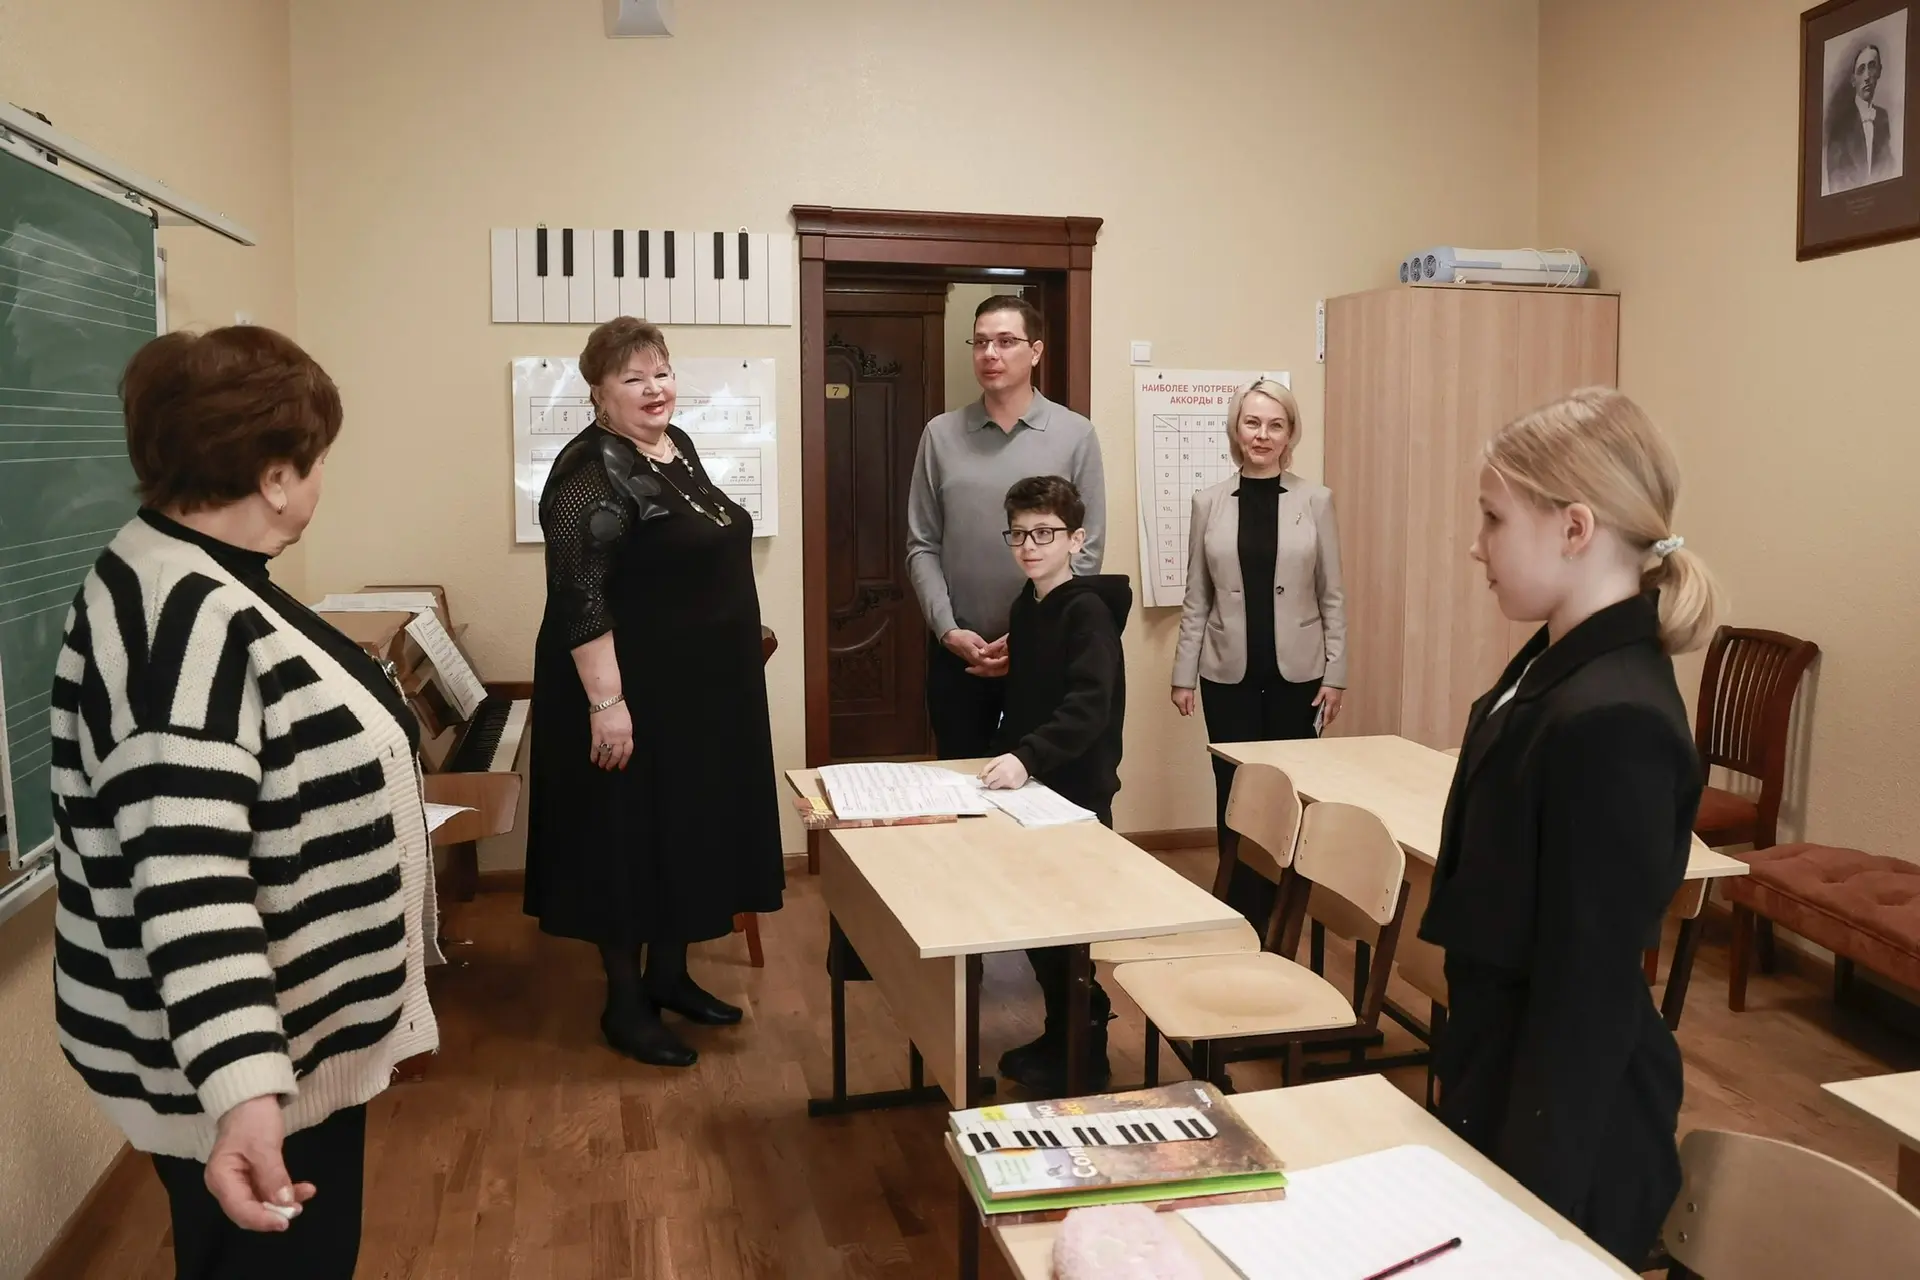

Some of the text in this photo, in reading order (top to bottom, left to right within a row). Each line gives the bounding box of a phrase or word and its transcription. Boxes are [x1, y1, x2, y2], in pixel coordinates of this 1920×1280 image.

[832, 387, 840, 396] 7
[1142, 384, 1239, 393] НАИБОЛЕЕ УПОТРЕБИ
[1170, 396, 1213, 405] АККОРДЫ
